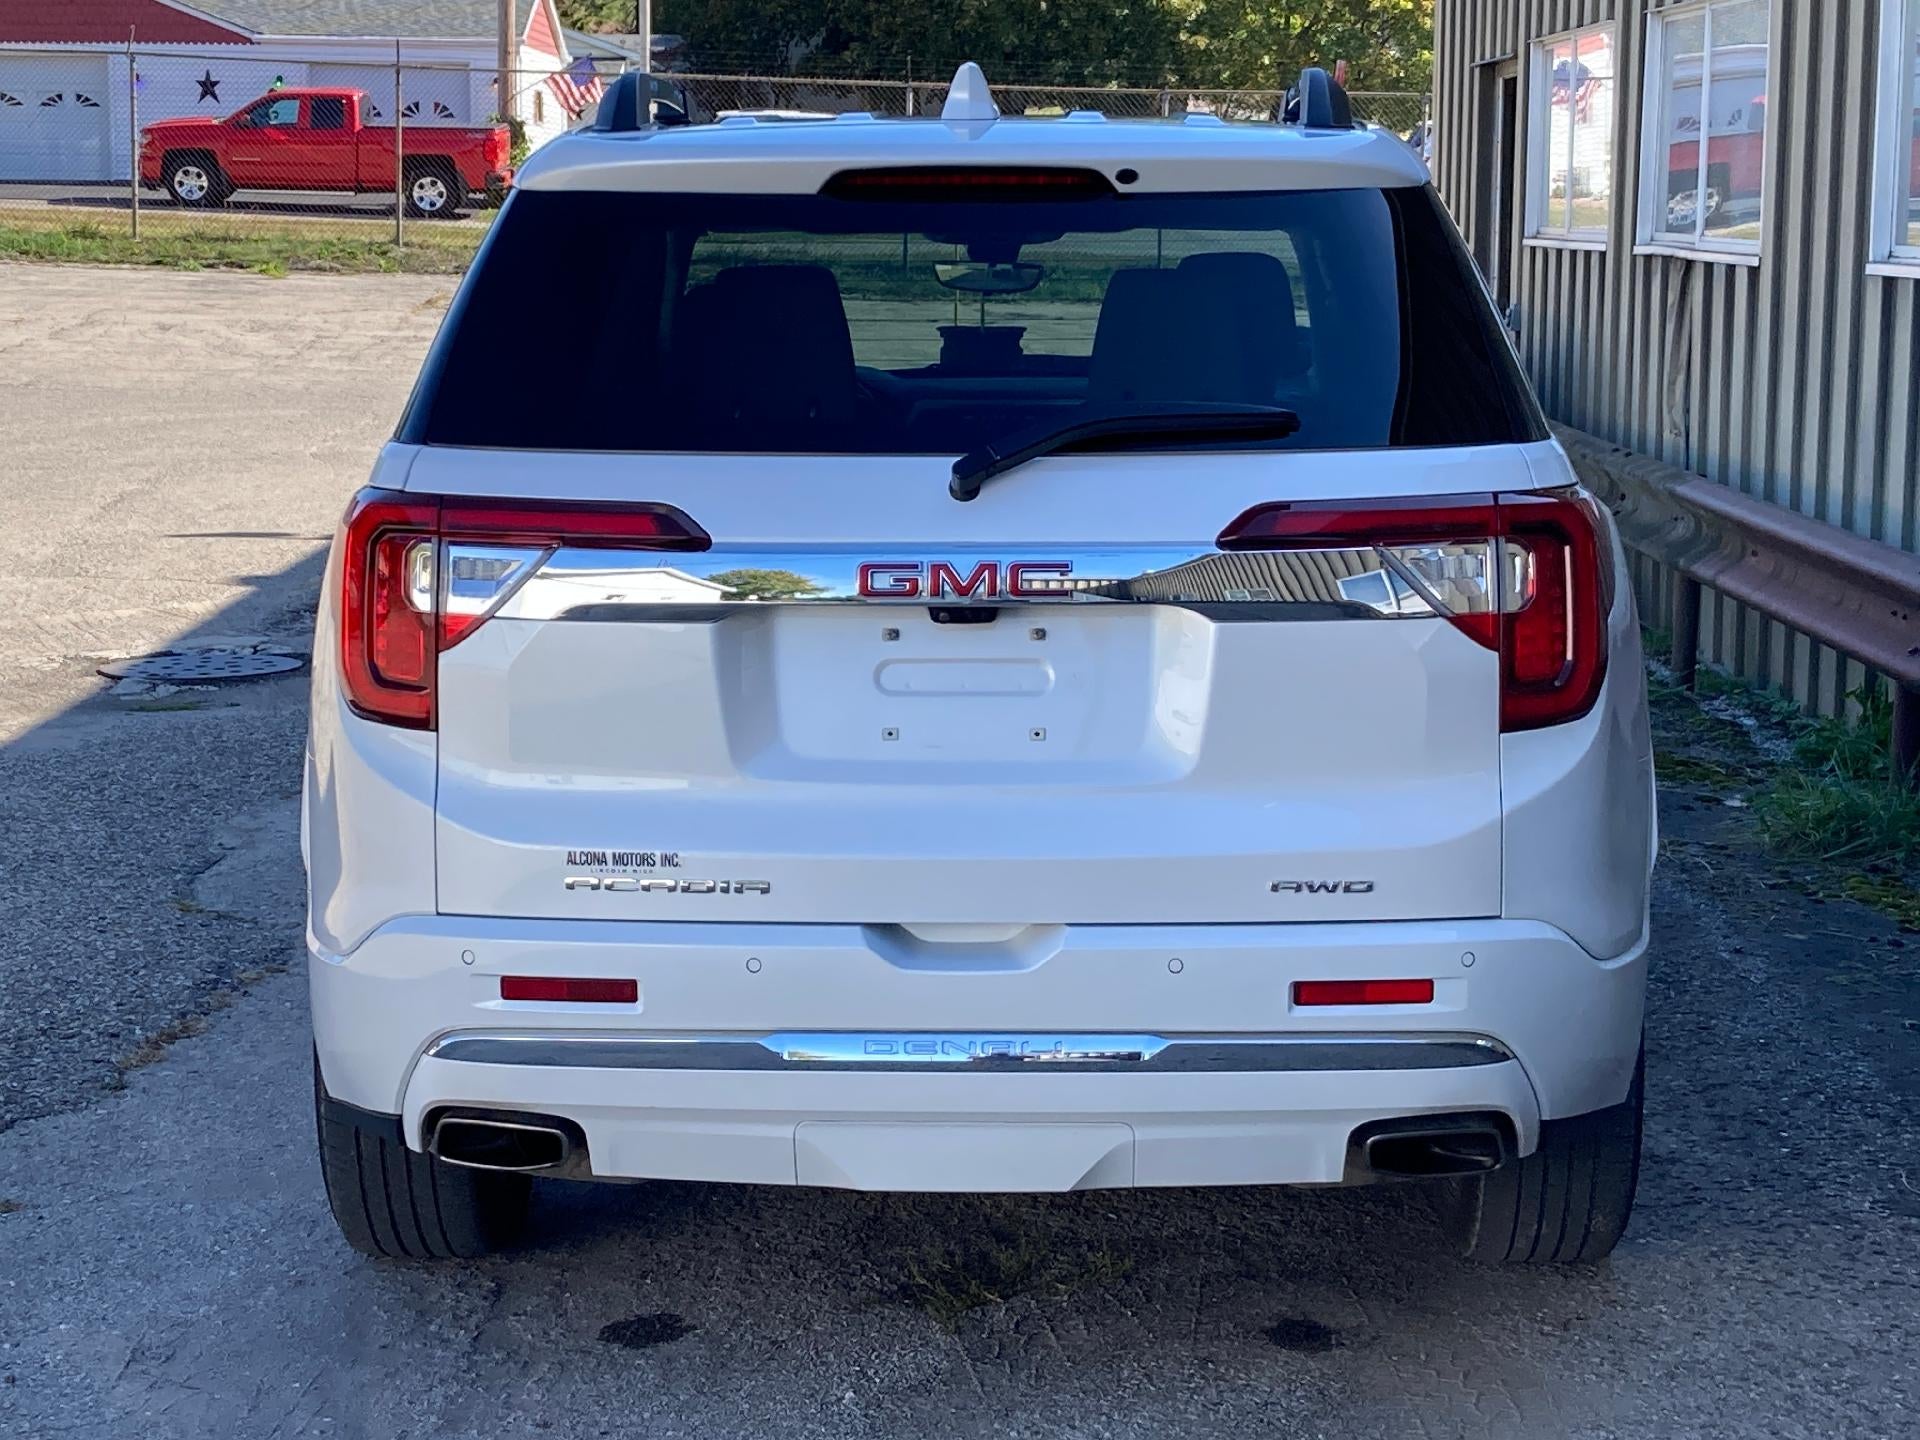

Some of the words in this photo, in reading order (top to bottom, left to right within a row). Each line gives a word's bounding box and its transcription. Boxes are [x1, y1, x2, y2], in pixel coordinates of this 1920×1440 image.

[857, 560, 1073, 600] GMC
[566, 851, 608, 867] ALCONA
[612, 852, 656, 867] MOTORS
[660, 853, 682, 868] INC.
[564, 876, 771, 895] ACADIA
[1270, 880, 1374, 893] AWD
[864, 1039, 1064, 1057] DENALI
